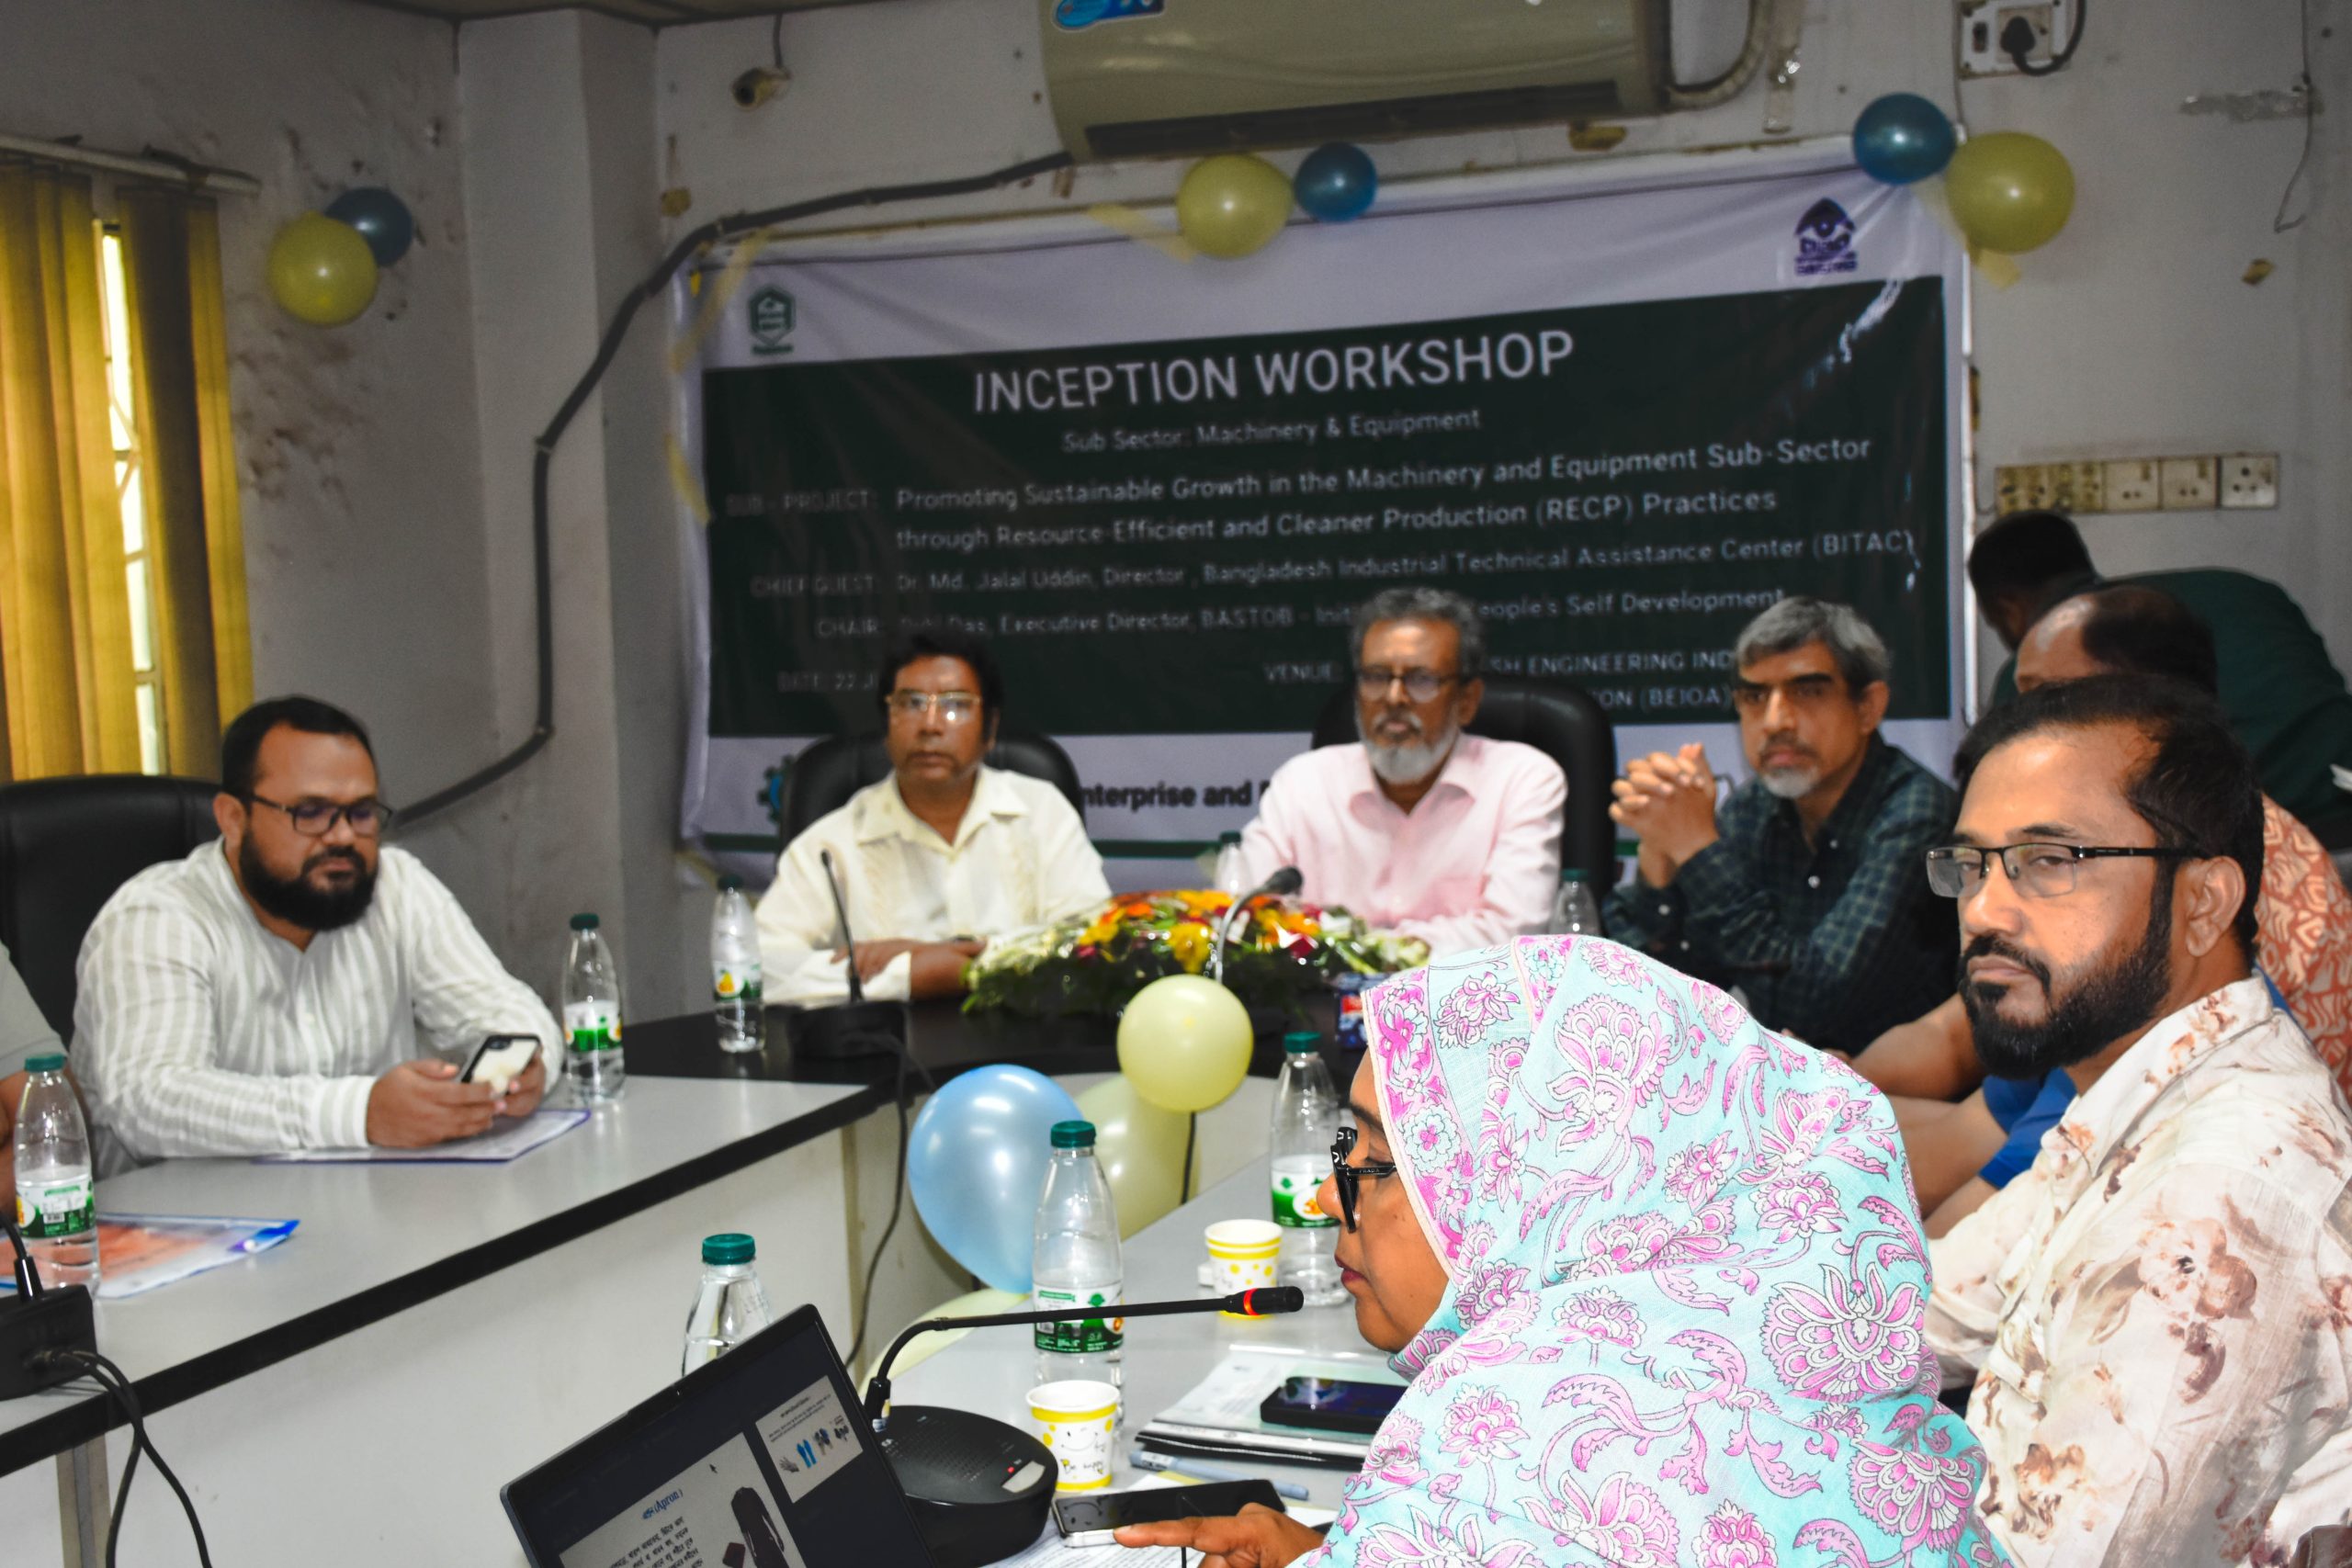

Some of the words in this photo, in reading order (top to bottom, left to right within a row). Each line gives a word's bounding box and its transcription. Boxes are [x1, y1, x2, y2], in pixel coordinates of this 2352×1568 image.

[974, 355, 1238, 412] INCEPTION
[1255, 330, 1574, 396] WORKSHOP
[1062, 431, 1106, 453] Sub
[1196, 420, 1317, 446] Machinery
[1325, 416, 1341, 438] &
[1349, 409, 1481, 439] Equipment
[897, 487, 1018, 512] Promoting
[1024, 477, 1163, 506] Sustainable
[1172, 473, 1261, 499] Growth
[1269, 473, 1292, 495] in
[1299, 470, 1339, 494] the
[1347, 462, 1485, 491] Machinery
[1494, 457, 1542, 480] and
[1550, 448, 1698, 480] Equipment
[897, 526, 989, 554] through
[1223, 513, 1269, 538] and
[1276, 510, 1374, 536] Cleaner
[1383, 502, 1527, 530] Production
[1535, 494, 1634, 527] (RECP)
[1643, 490, 1777, 515] Practices
[751, 574, 808, 597] CHIEF
[1203, 560, 1332, 587] Bangladesh
[1338, 553, 1448, 577] Industrial
[1455, 548, 1569, 572] Technical
[1577, 543, 1713, 567] Assistance
[1721, 537, 1804, 560] Center
[1000, 612, 1098, 634] Executive
[1477, 594, 1559, 621] eople's
[1566, 592, 1613, 615] Self
[1622, 589, 1786, 615] Development
[1528, 651, 1684, 676] ENGINEERING
[1082, 782, 1196, 811] nterprise
[1204, 780, 1251, 807] and
